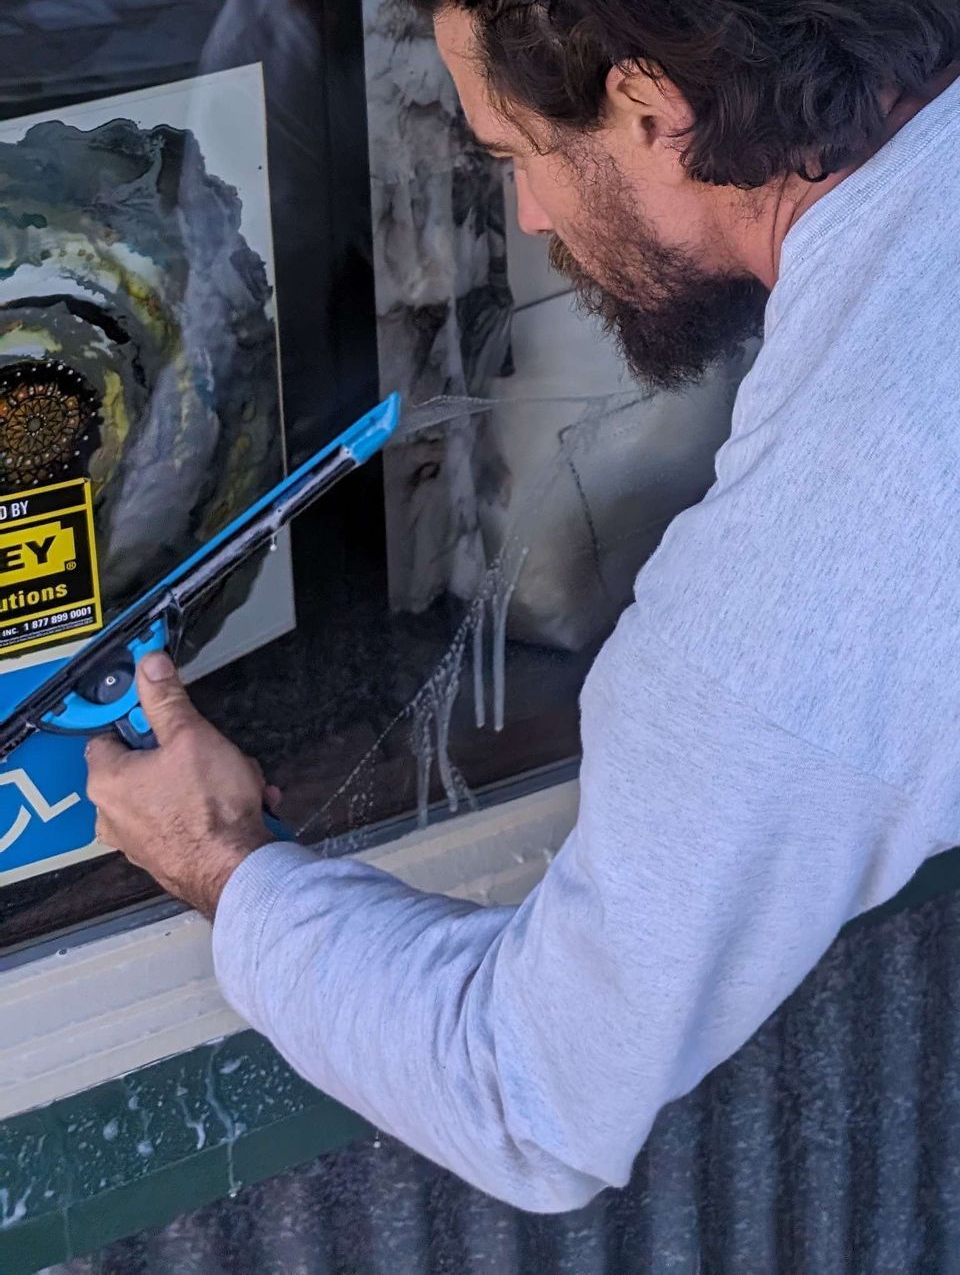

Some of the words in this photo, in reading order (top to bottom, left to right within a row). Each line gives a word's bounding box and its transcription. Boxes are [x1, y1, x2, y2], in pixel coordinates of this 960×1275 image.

[11, 500, 29, 518] BY
[24, 622, 29, 631] 1
[32, 617, 49, 629] 877
[51, 612, 68, 624] 899
[70, 606, 92, 619] 0001
